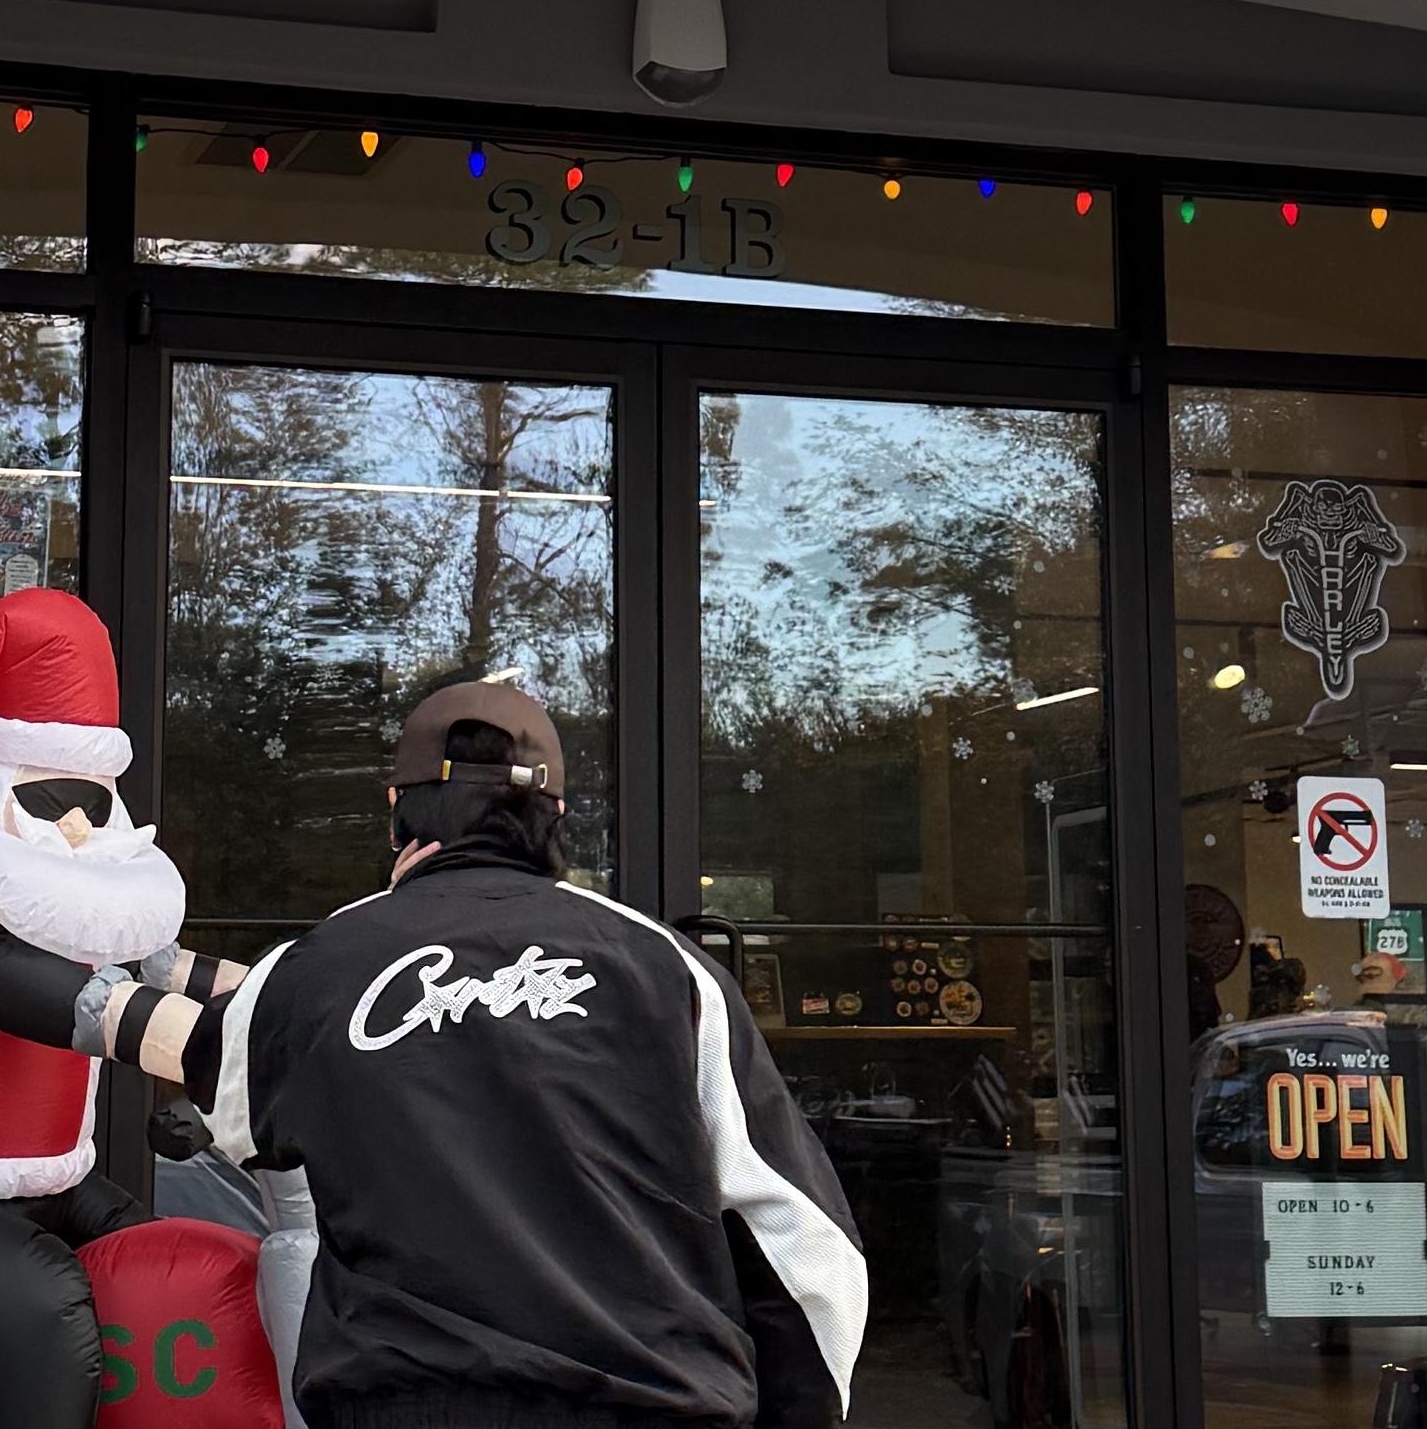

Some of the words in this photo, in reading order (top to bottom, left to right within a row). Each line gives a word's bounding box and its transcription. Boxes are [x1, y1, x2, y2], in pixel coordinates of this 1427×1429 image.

[485, 180, 786, 278] 32-1B
[1311, 876, 1322, 885] NO
[1308, 888, 1345, 898] WEAPONS
[1348, 889, 1384, 898] ALLOWED
[1286, 1048, 1337, 1068] Yes...
[1342, 1049, 1390, 1069] we're
[1267, 1073, 1408, 1159] OPEN
[1278, 1200, 1318, 1213] OPEN
[1307, 1255, 1376, 1269] SUNDAY
